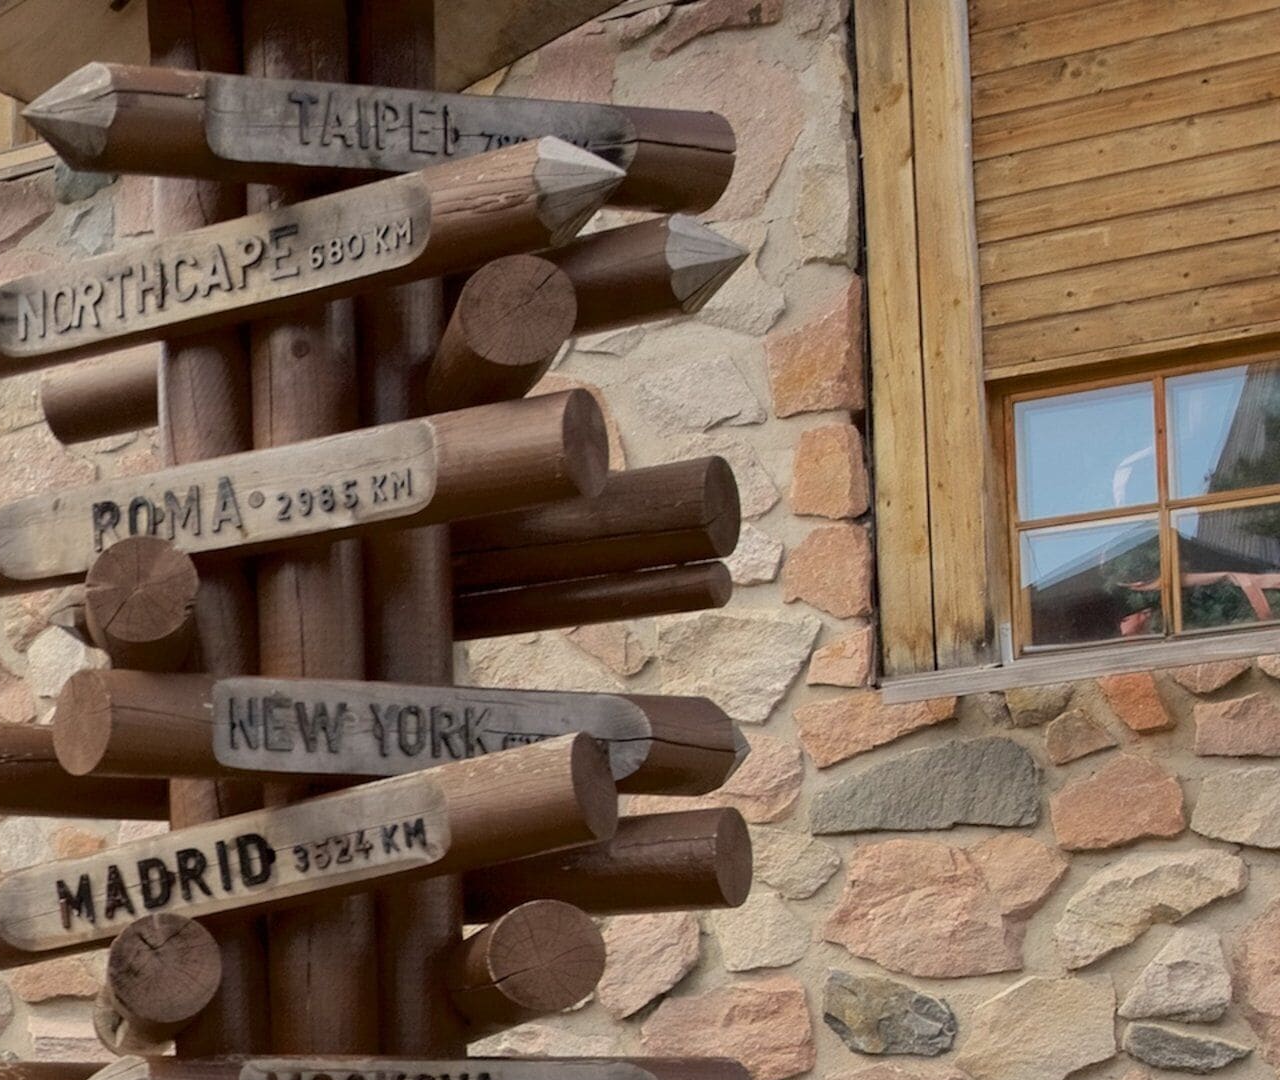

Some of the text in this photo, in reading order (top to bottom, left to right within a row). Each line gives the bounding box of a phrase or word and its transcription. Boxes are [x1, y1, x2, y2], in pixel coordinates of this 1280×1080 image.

[289, 91, 455, 157] TAIPEI
[17, 218, 414, 342] NORTHCAPE 680 KM
[91, 468, 413, 553] ROMA 2985 KM
[228, 697, 490, 761] NEW YORK
[56, 817, 429, 930] MADRID 3524 KM
